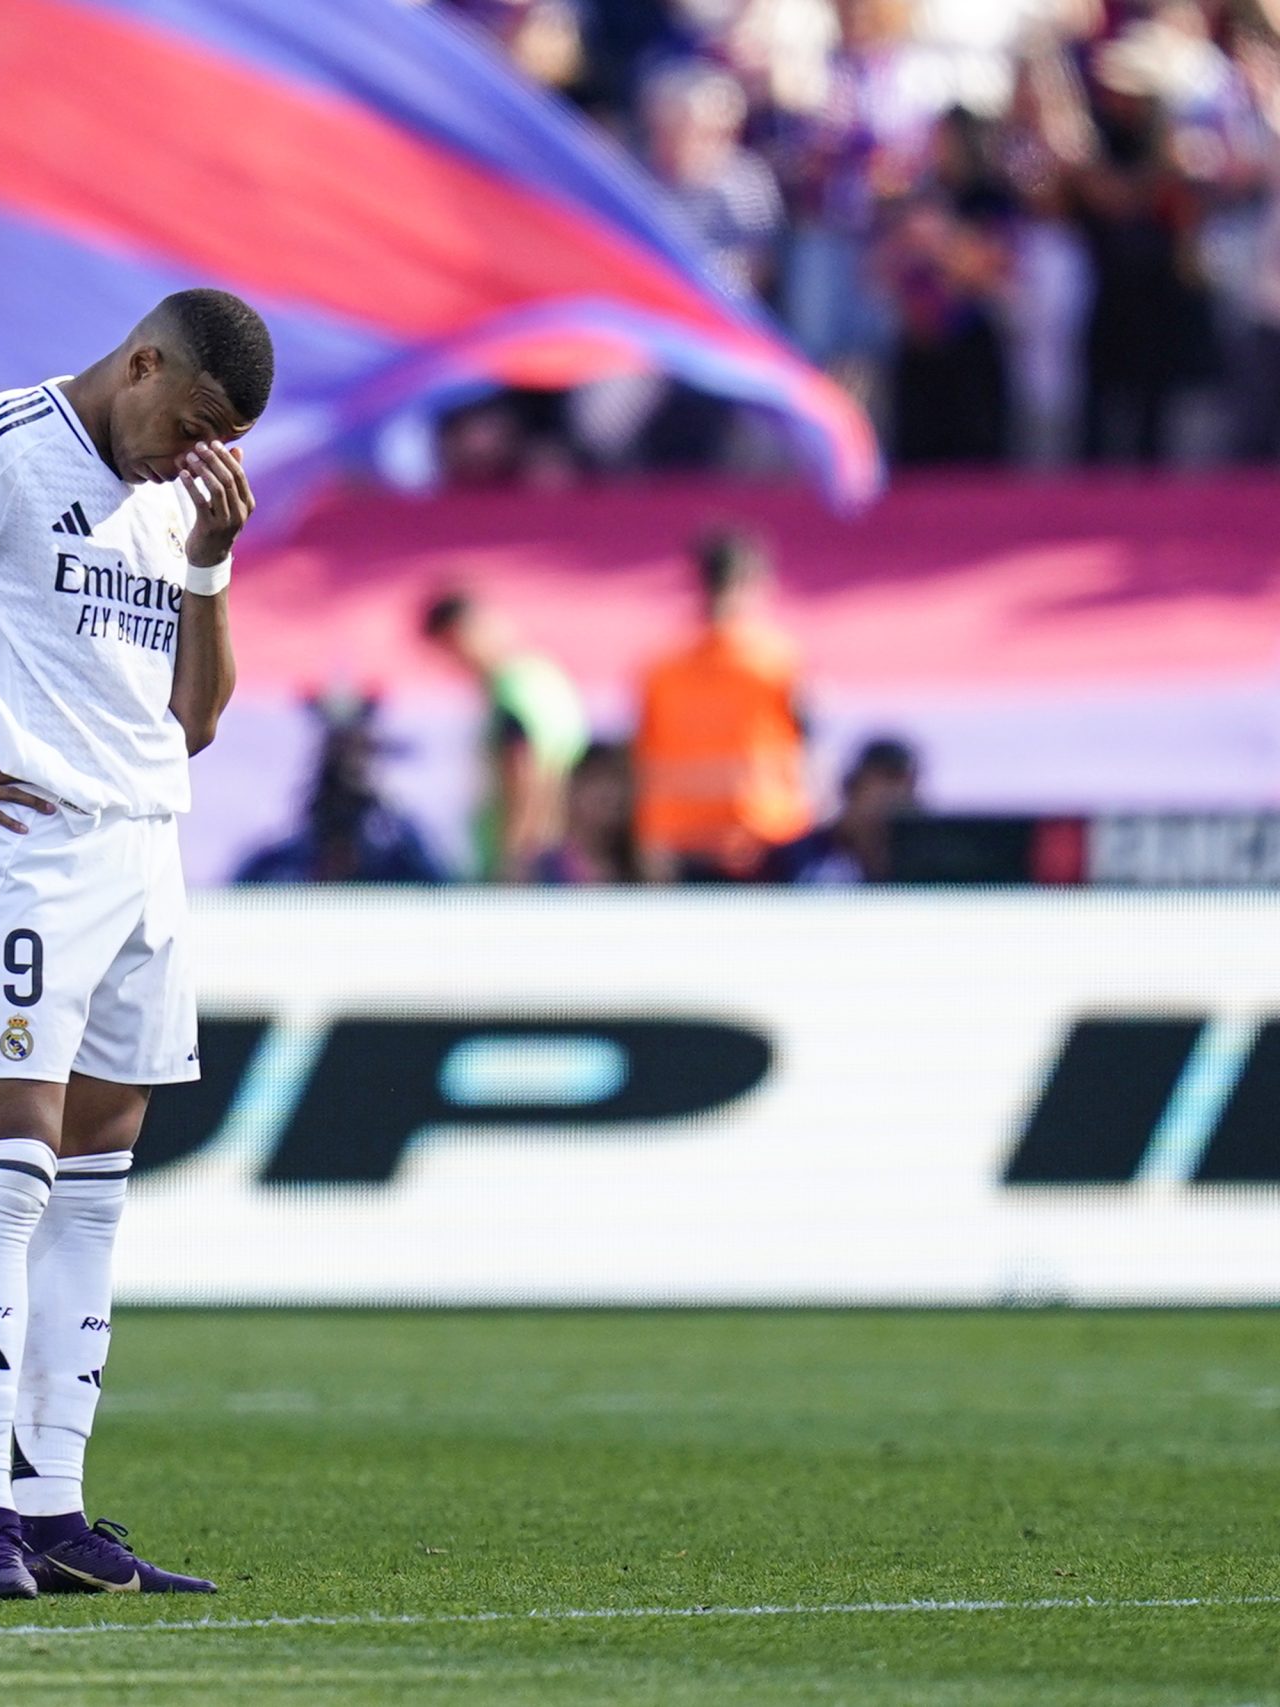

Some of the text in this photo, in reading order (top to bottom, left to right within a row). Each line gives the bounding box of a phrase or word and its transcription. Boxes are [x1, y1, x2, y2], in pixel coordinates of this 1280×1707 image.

[54, 552, 183, 614] Emirate
[76, 604, 175, 653] FLY BETTER
[3, 928, 43, 1007] 9
[80, 1316, 112, 1333] RM
